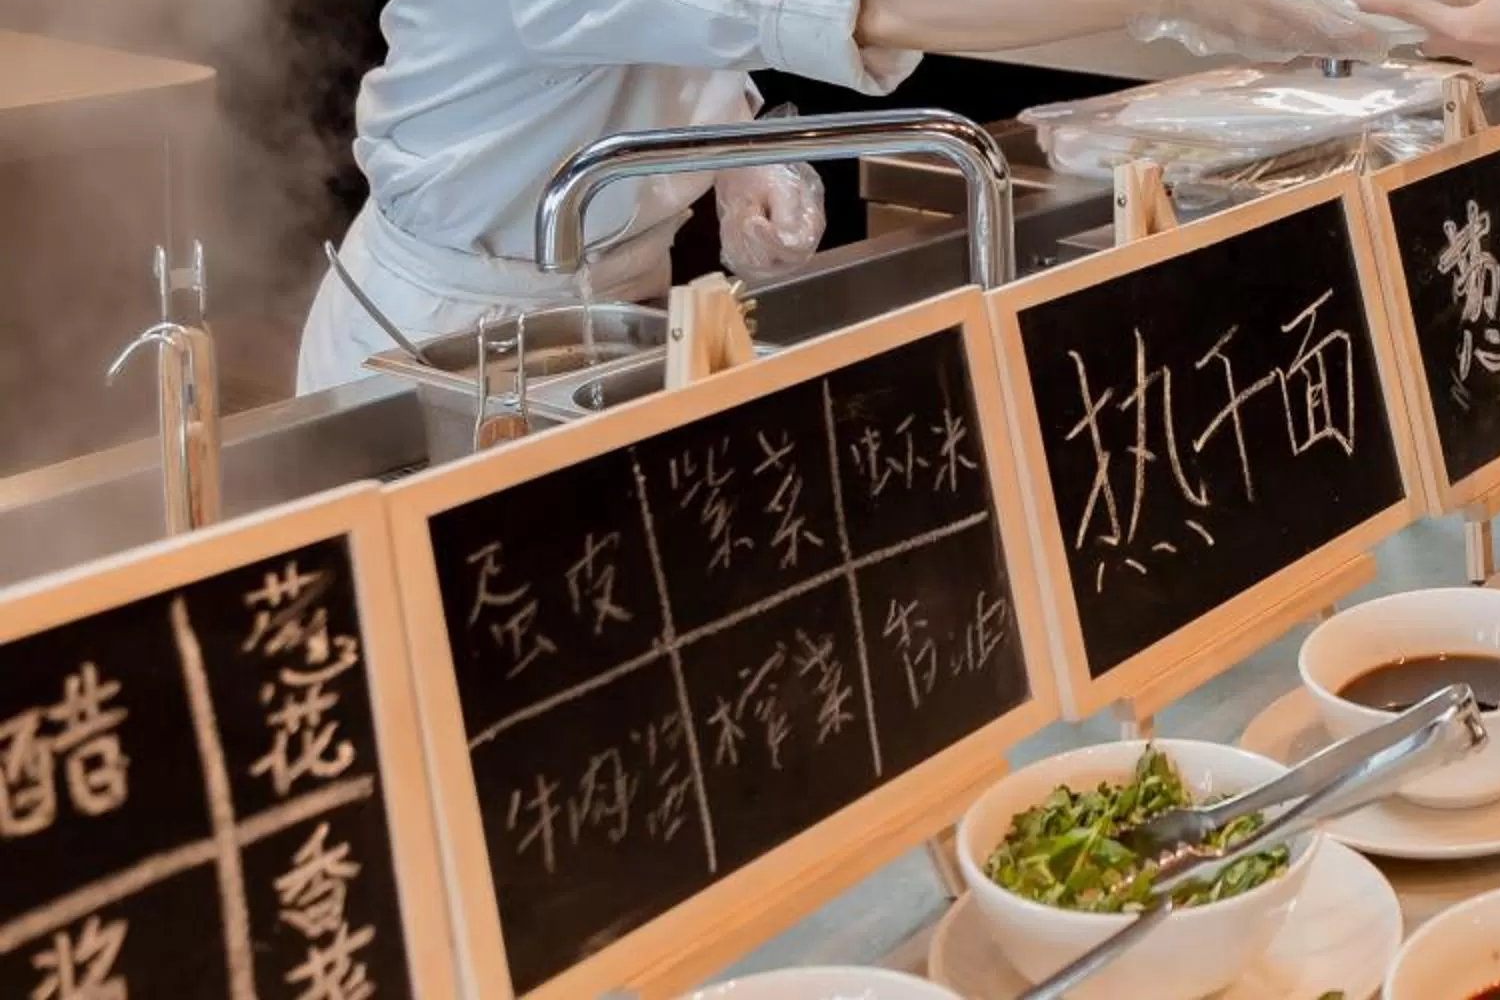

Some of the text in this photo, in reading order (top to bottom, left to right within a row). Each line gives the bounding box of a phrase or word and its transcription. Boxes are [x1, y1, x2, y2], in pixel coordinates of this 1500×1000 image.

[668, 430, 825, 572] 紫菜
[850, 407, 979, 500] 虾米
[1065, 288, 1355, 593] 热干面
[465, 530, 635, 682] 蛋皮
[706, 627, 856, 770] 榨菜
